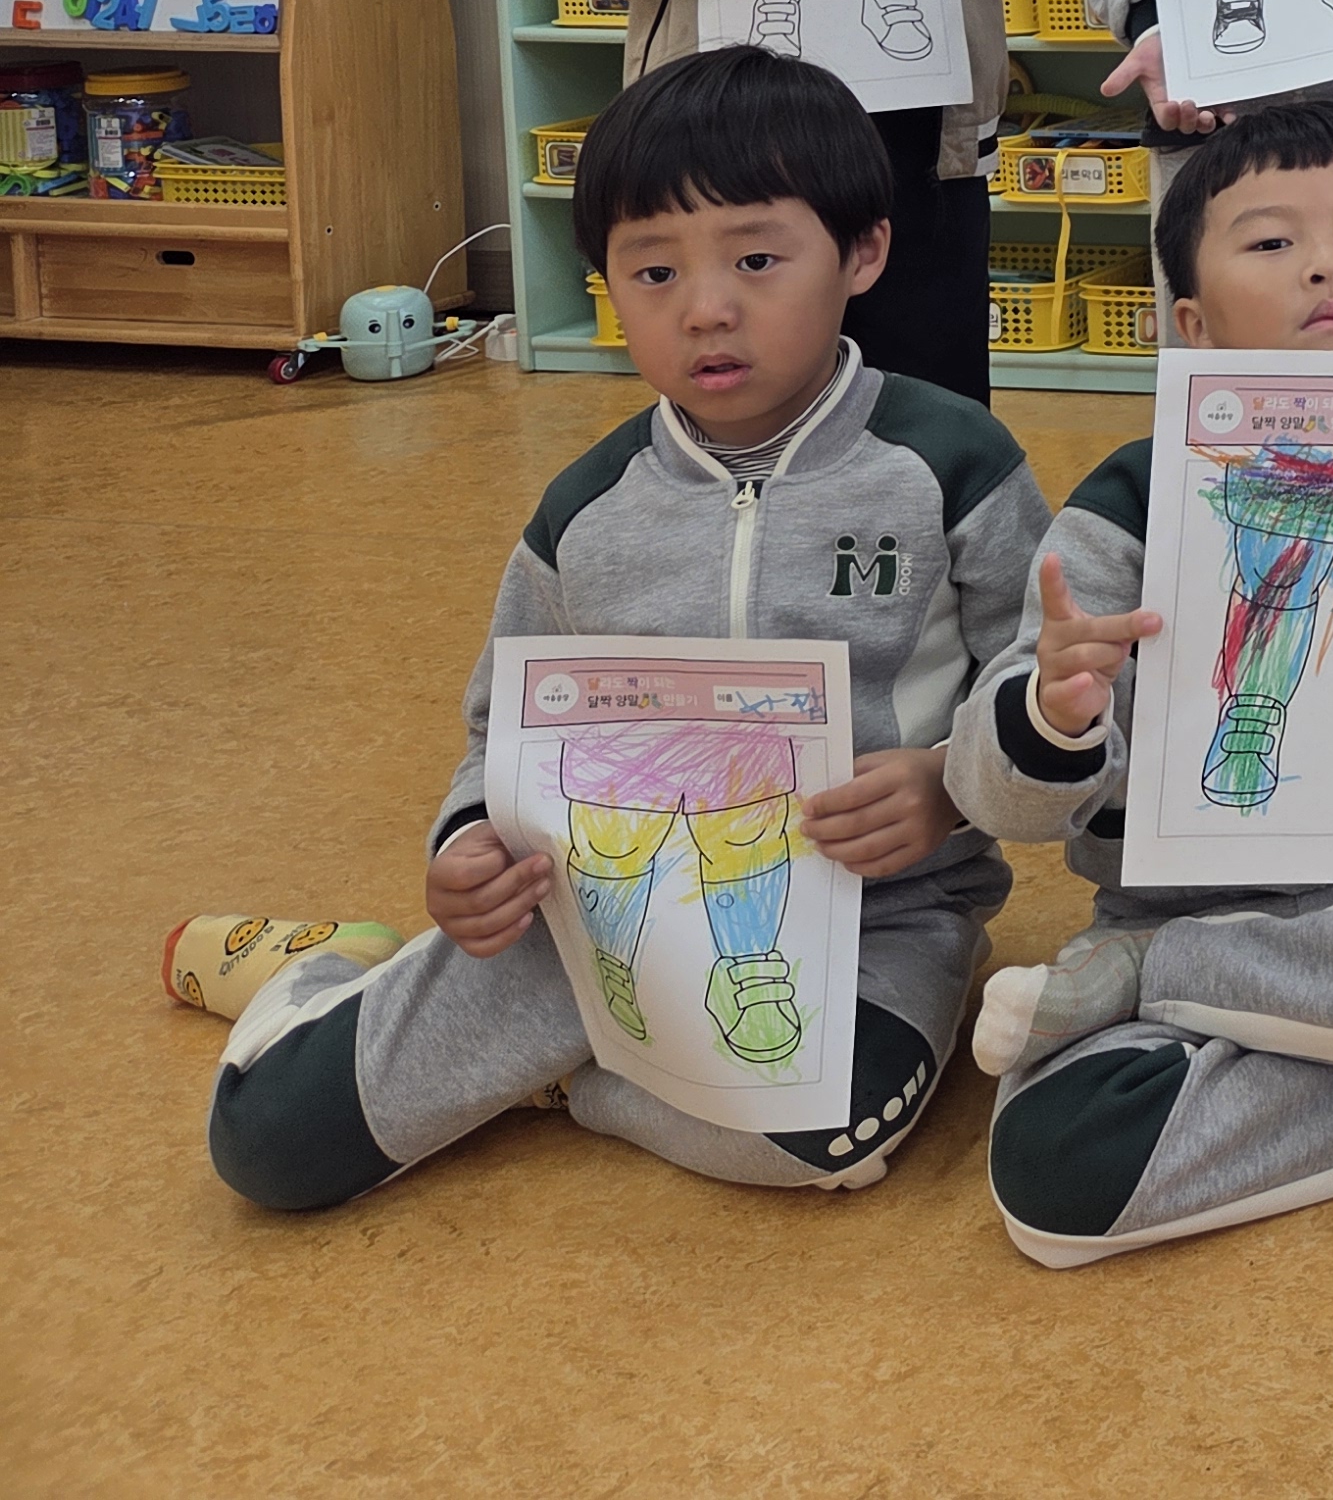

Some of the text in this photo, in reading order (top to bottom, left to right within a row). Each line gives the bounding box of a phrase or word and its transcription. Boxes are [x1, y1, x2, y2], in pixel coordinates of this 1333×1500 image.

[1252, 397, 1290, 410] 달라도
[1293, 396, 1318, 410] 짝이
[1251, 416, 1275, 430] 달짝
[1280, 416, 1304, 430] 양말
[587, 678, 625, 691] 달라도
[627, 677, 650, 690] 짝이
[587, 695, 611, 708] 달짝
[616, 694, 639, 708] 양말
[717, 693, 733, 703] 이름
